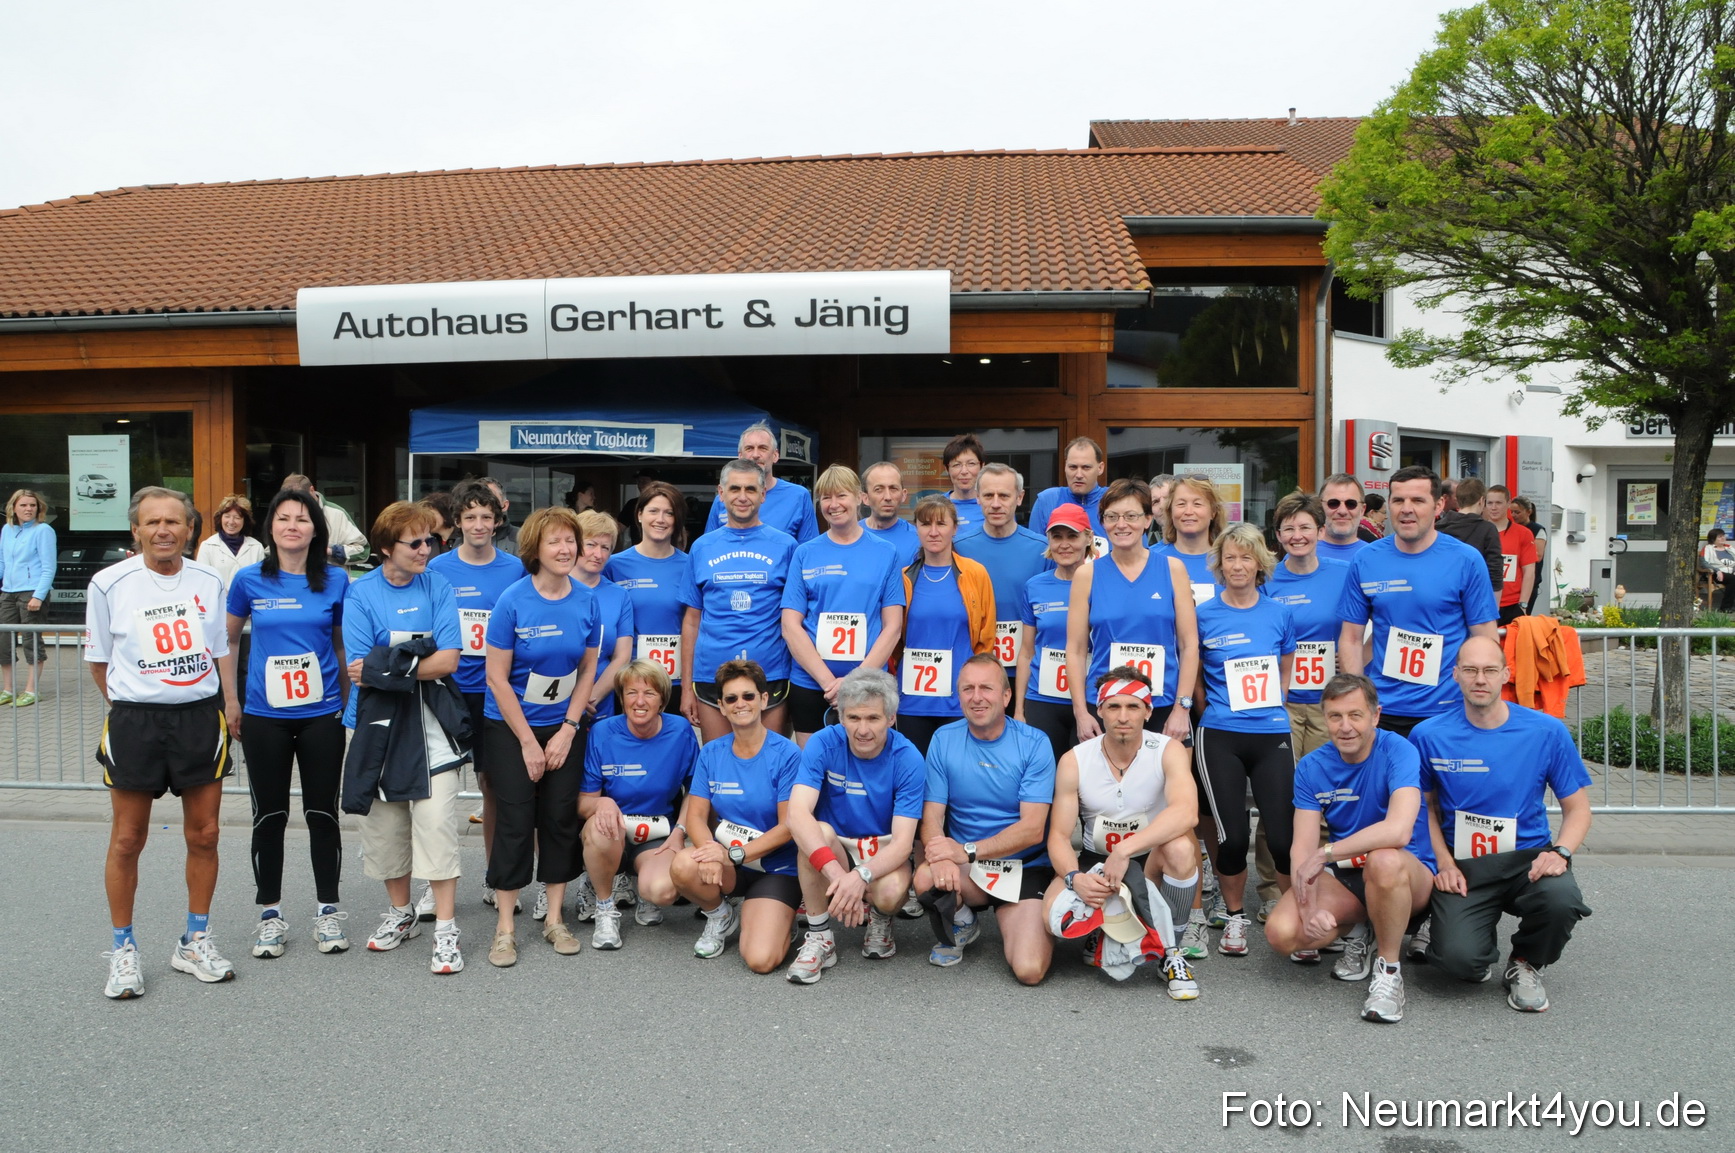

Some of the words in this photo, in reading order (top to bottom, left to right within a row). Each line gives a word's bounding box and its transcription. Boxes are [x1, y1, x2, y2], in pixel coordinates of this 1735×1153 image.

[333, 308, 528, 341] Autohaus
[550, 302, 724, 334] Gerhart
[743, 299, 776, 328] &
[794, 296, 910, 335] Jänig
[517, 429, 591, 446] Neumarkter
[594, 430, 648, 449] Tagblatt
[708, 551, 774, 567] funrunners
[144, 606, 174, 617] MEYER
[152, 619, 192, 654] 86
[470, 624, 484, 650] 3
[832, 627, 856, 654] 21
[1398, 632, 1421, 642] MEYER
[1234, 660, 1260, 668] MEYER
[1296, 657, 1324, 685] 55
[1400, 646, 1426, 678] 16
[282, 670, 310, 700] 13
[913, 665, 938, 692] 72
[1242, 673, 1268, 704] 67
[543, 679, 560, 700] 4
[726, 824, 748, 836] MEYER
[1102, 820, 1128, 828] MEYER
[1465, 814, 1492, 825] MEYER
[634, 823, 650, 843] 9
[1471, 832, 1498, 858] 61
[986, 873, 1000, 891] 7
